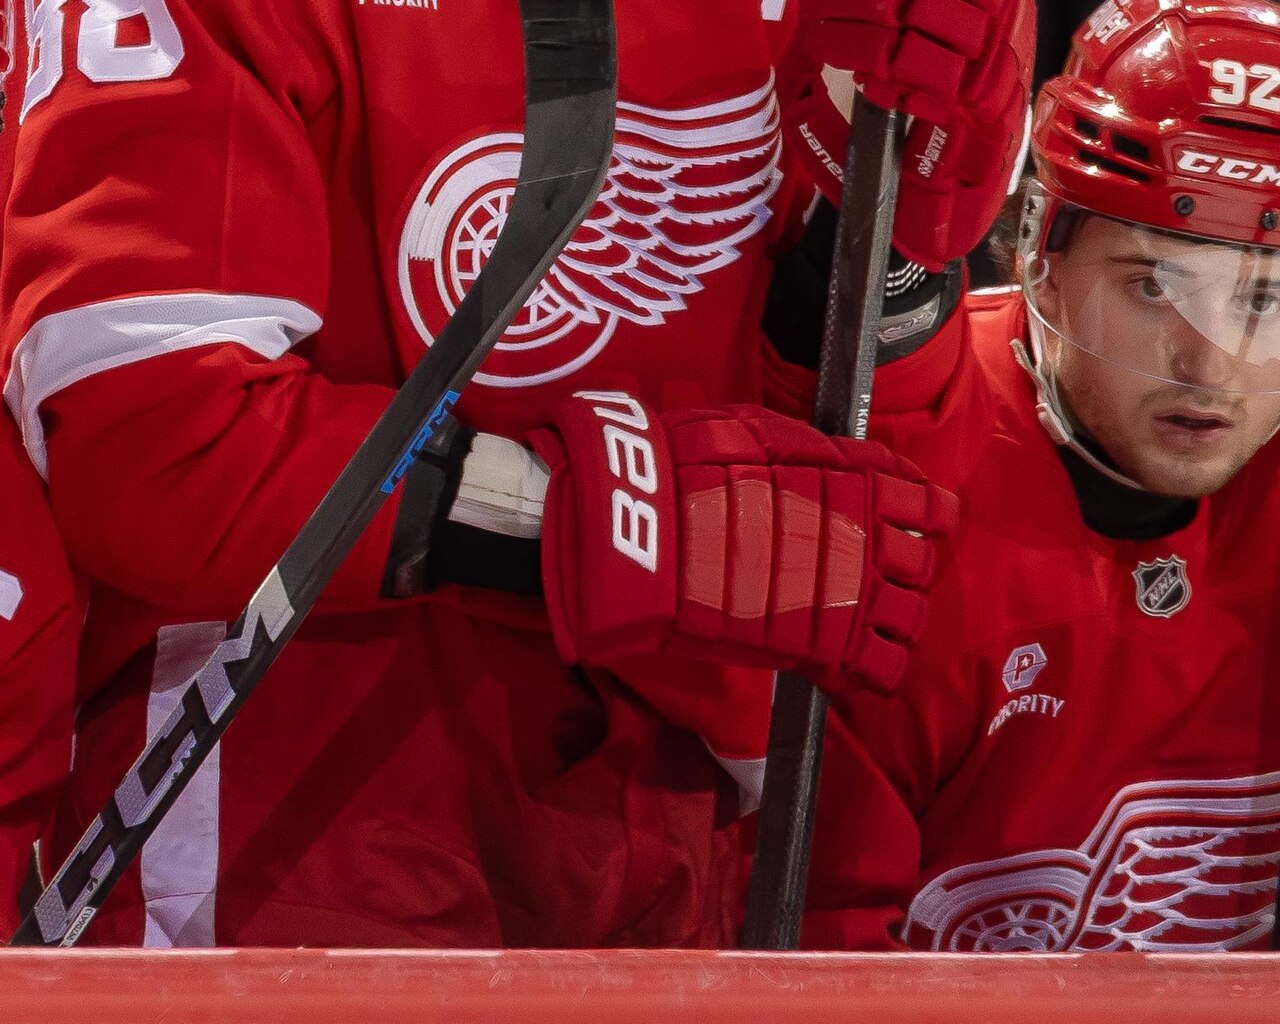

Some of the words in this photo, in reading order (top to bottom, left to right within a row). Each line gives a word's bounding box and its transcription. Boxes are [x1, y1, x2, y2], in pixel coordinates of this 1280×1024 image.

[1210, 58, 1280, 113] 92
[1176, 149, 1280, 187] CCM
[854, 408, 869, 440] KAN
[1147, 571, 1177, 606] NHL
[987, 693, 1065, 736] PRIORITY
[34, 565, 296, 943] CCM
